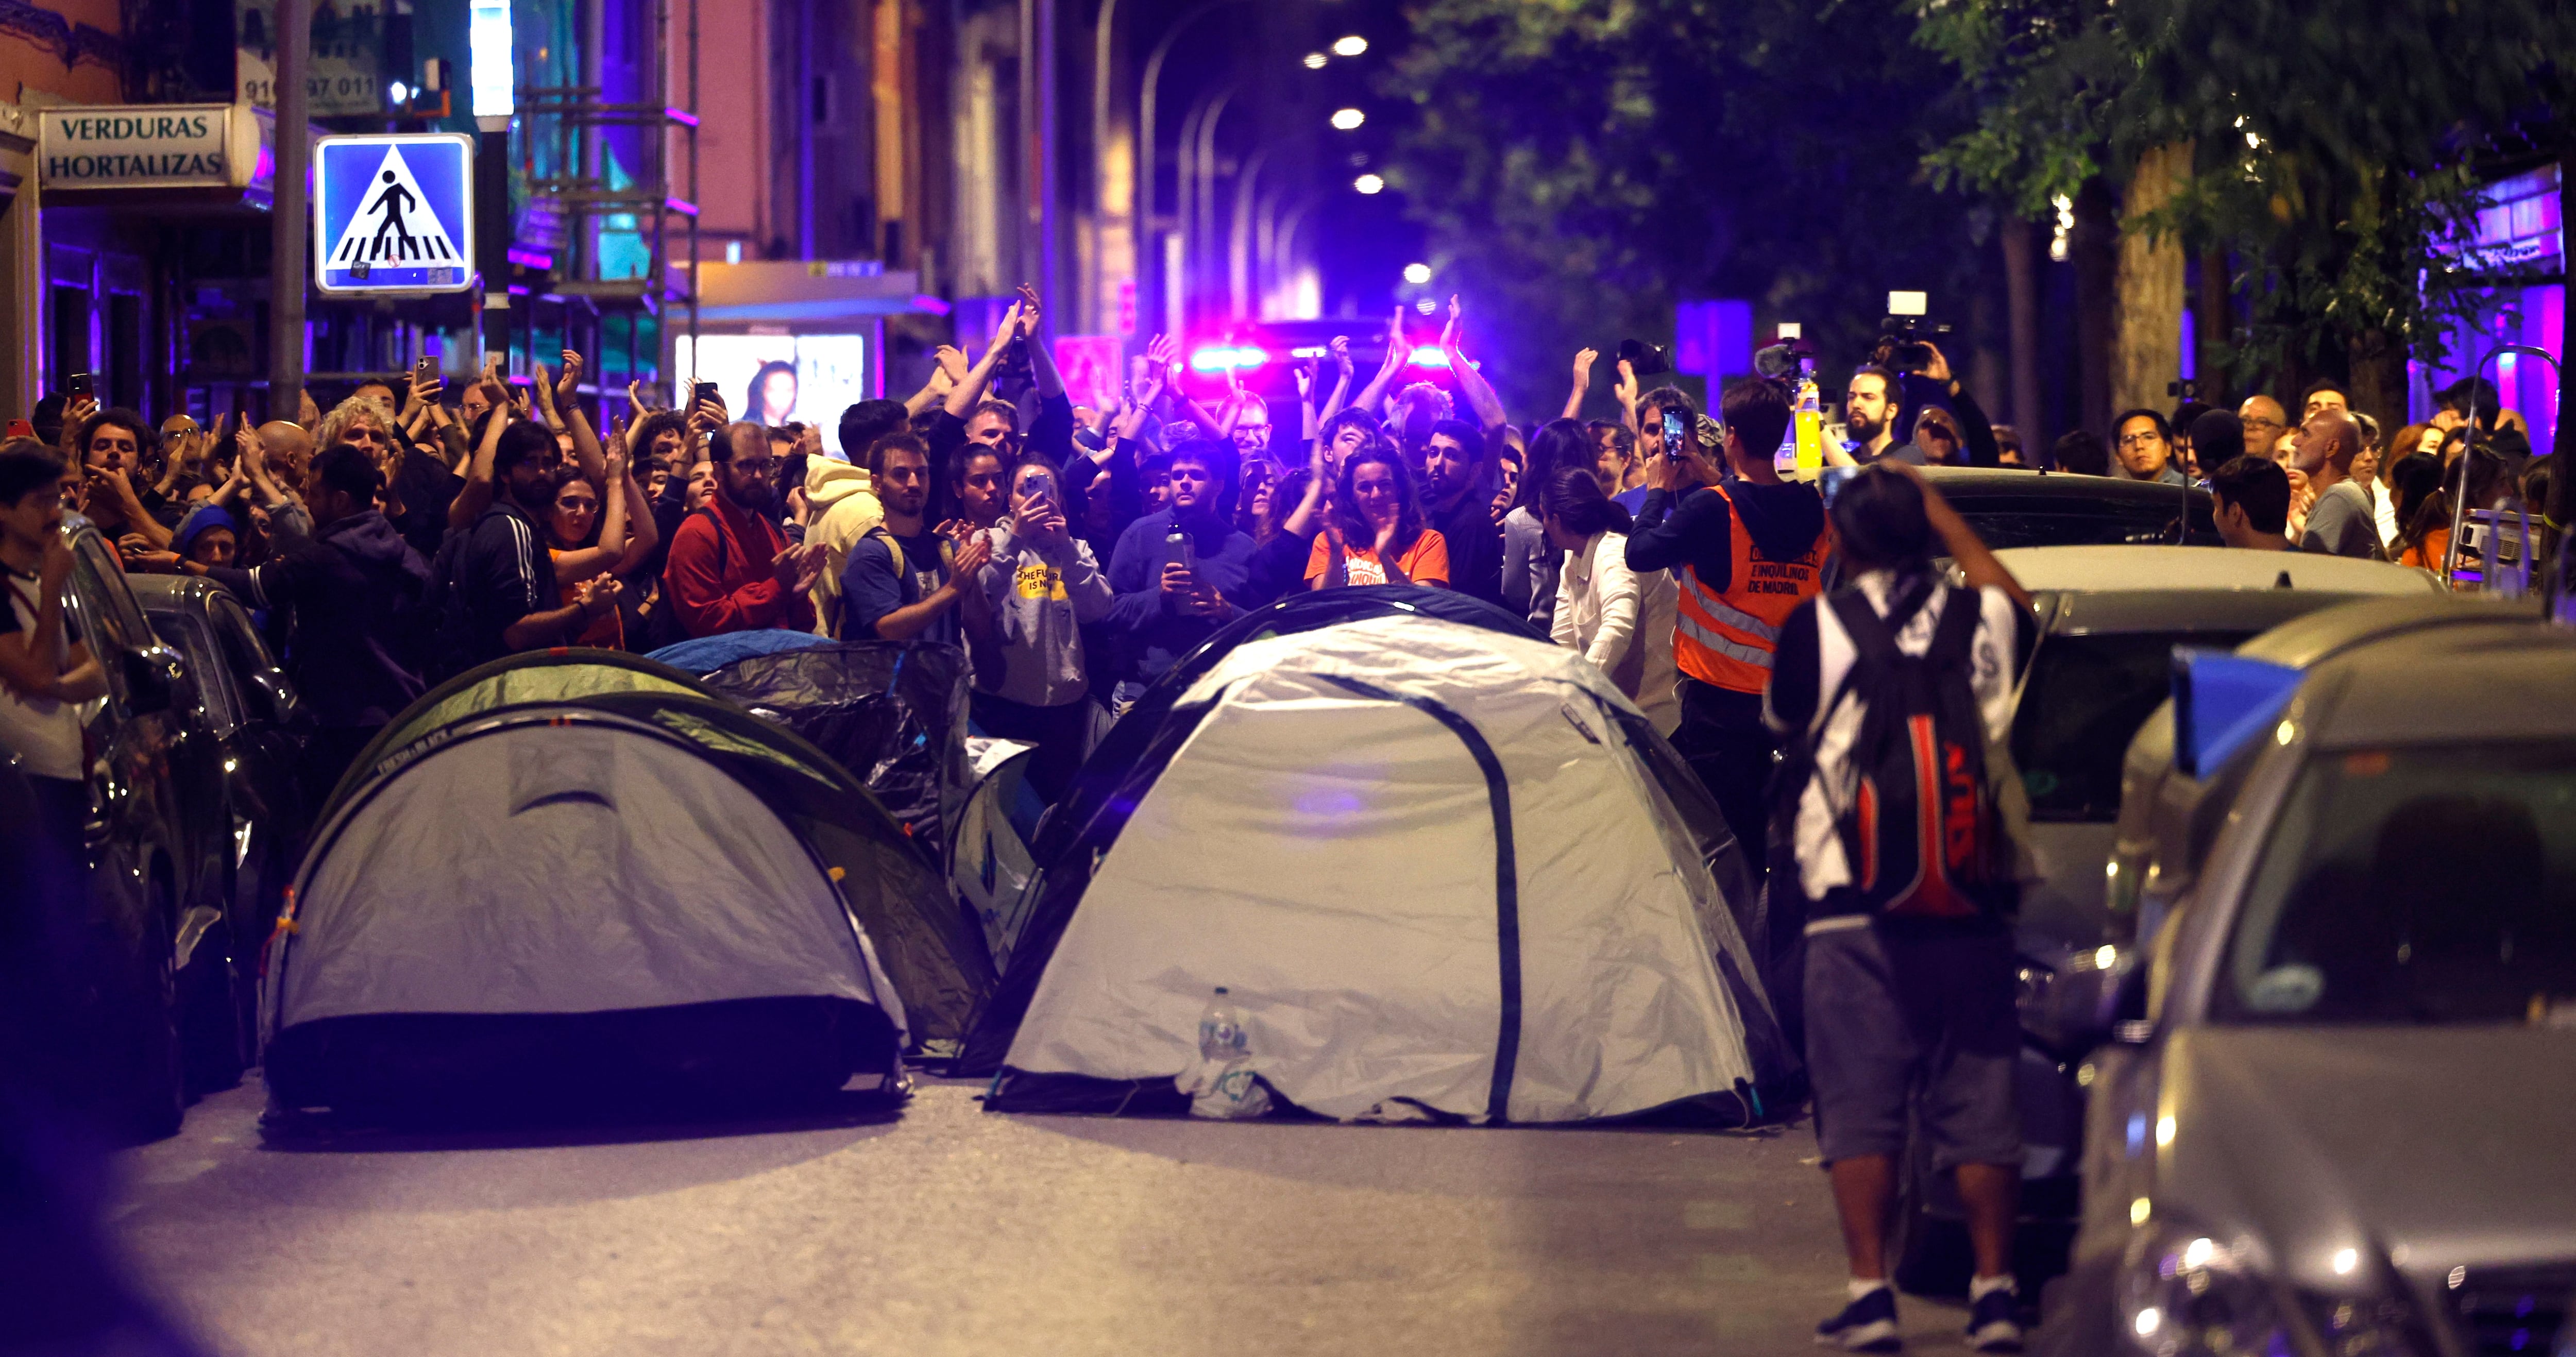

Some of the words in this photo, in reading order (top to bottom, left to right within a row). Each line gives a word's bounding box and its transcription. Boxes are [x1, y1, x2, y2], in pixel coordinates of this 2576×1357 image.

[338, 77, 374, 96] 011
[61, 116, 207, 140] VERDURAS
[50, 153, 223, 178] HORTALIZAS
[1019, 569, 1035, 580] THE
[1029, 581, 1037, 590] IS
[1748, 581, 1760, 593] DE
